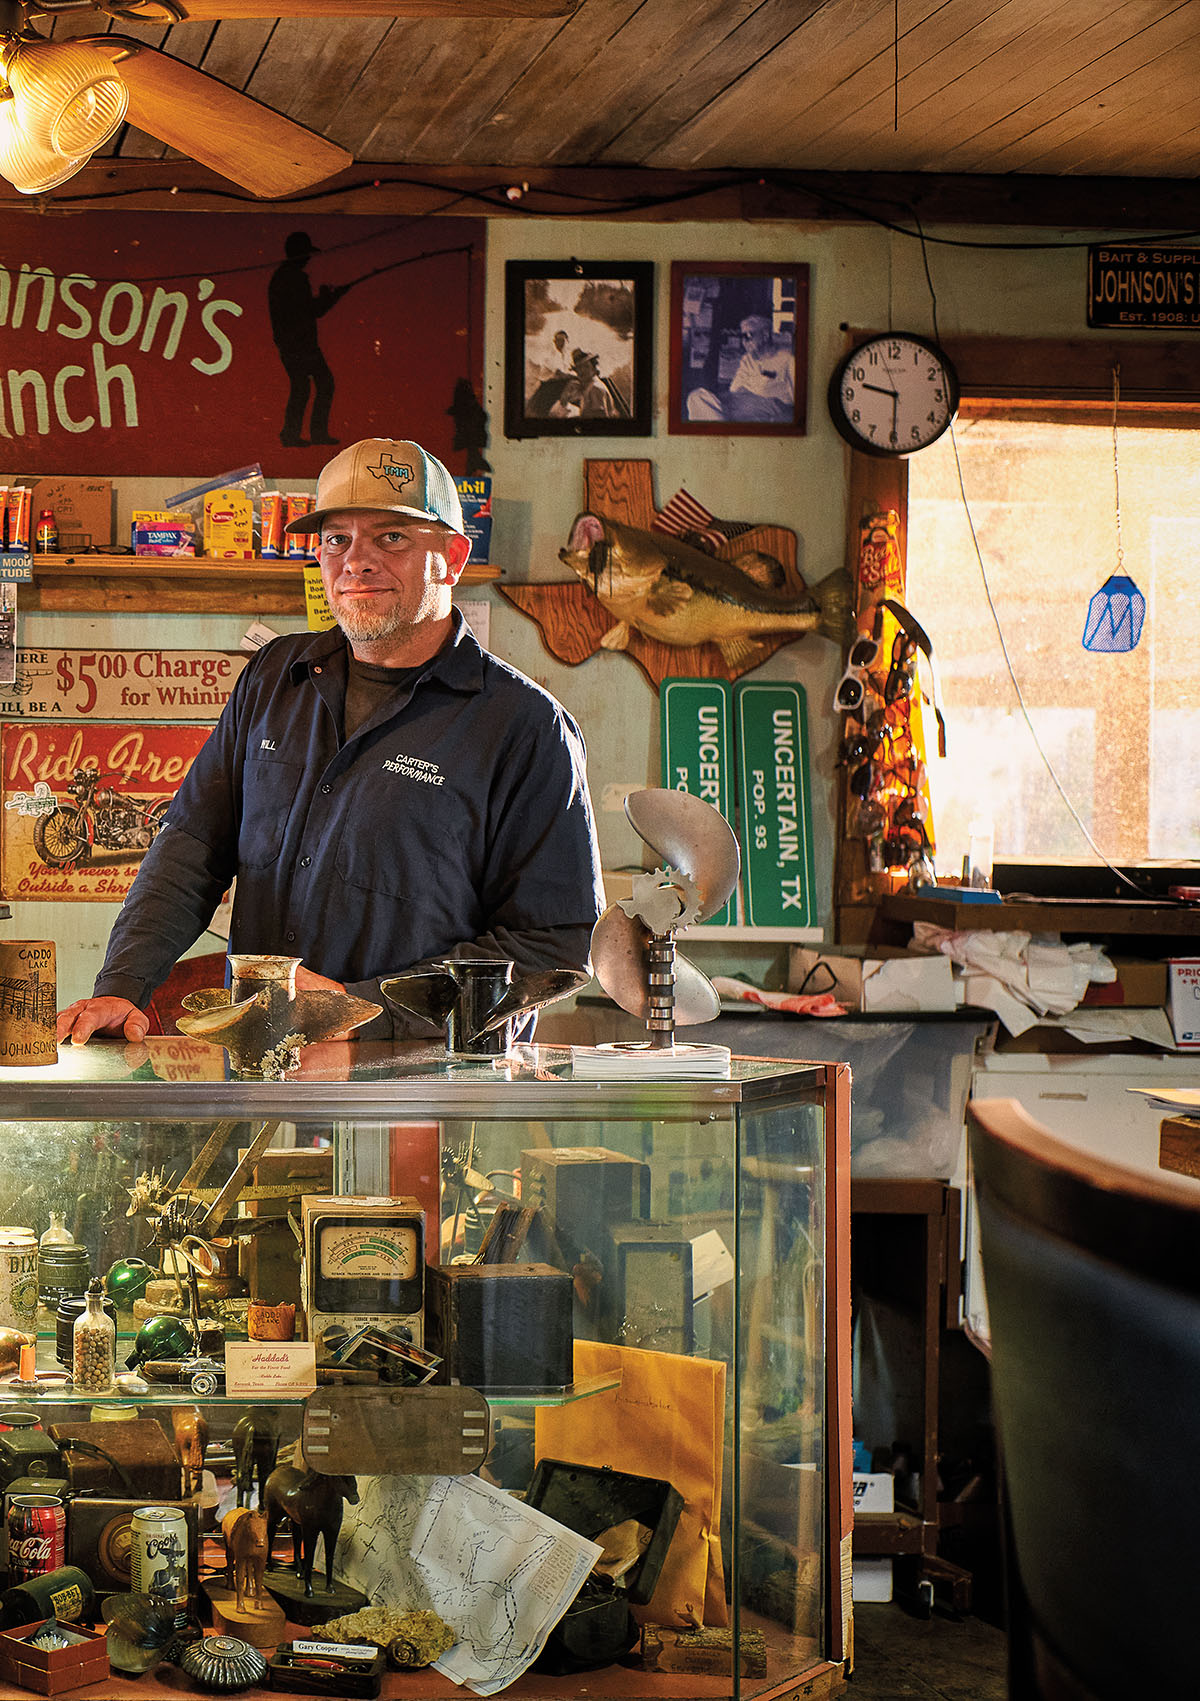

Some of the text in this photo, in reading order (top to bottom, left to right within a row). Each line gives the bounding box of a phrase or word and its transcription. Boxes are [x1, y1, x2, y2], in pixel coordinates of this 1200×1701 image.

[1137, 252, 1148, 264] &
[1095, 269, 1195, 305] JOHNSON'S
[888, 342, 901, 360] 12
[869, 352, 878, 366] 11
[914, 352, 918, 366] 1
[852, 368, 865, 382] 10
[927, 367, 937, 381] 2
[845, 387, 855, 401] 9
[935, 388, 943, 403] 3
[852, 409, 861, 423] 8
[926, 411, 936, 424] 4
[868, 424, 877, 438] 7
[911, 425, 920, 441] 5
[383, 465, 409, 479] TMM
[147, 532, 178, 540] TAMPAX
[3, 557, 31, 568] MOOD
[15, 653, 49, 664] ERE
[133, 652, 232, 687] Charge
[120, 686, 233, 707] for Whinin
[28, 701, 48, 713] BE
[51, 702, 62, 713] A
[10, 729, 101, 784] Ride
[395, 754, 440, 774] CARTER'S
[381, 760, 446, 787] PERFORMANCE
[751, 769, 767, 850] POP. 93
[771, 709, 802, 910] UNCERTAIN, TX
[28, 861, 77, 880] You'll
[78, 867, 120, 877] never
[17, 877, 74, 893] Outside
[78, 885, 89, 893] a
[18, 949, 52, 961] CADDO
[28, 960, 49, 969] LAKE
[256, 1310, 281, 1319] CADDO
[252, 1353, 290, 1363] Haddad's
[298, 1643, 314, 1652] Gary
[315, 1644, 339, 1653] Cooper
